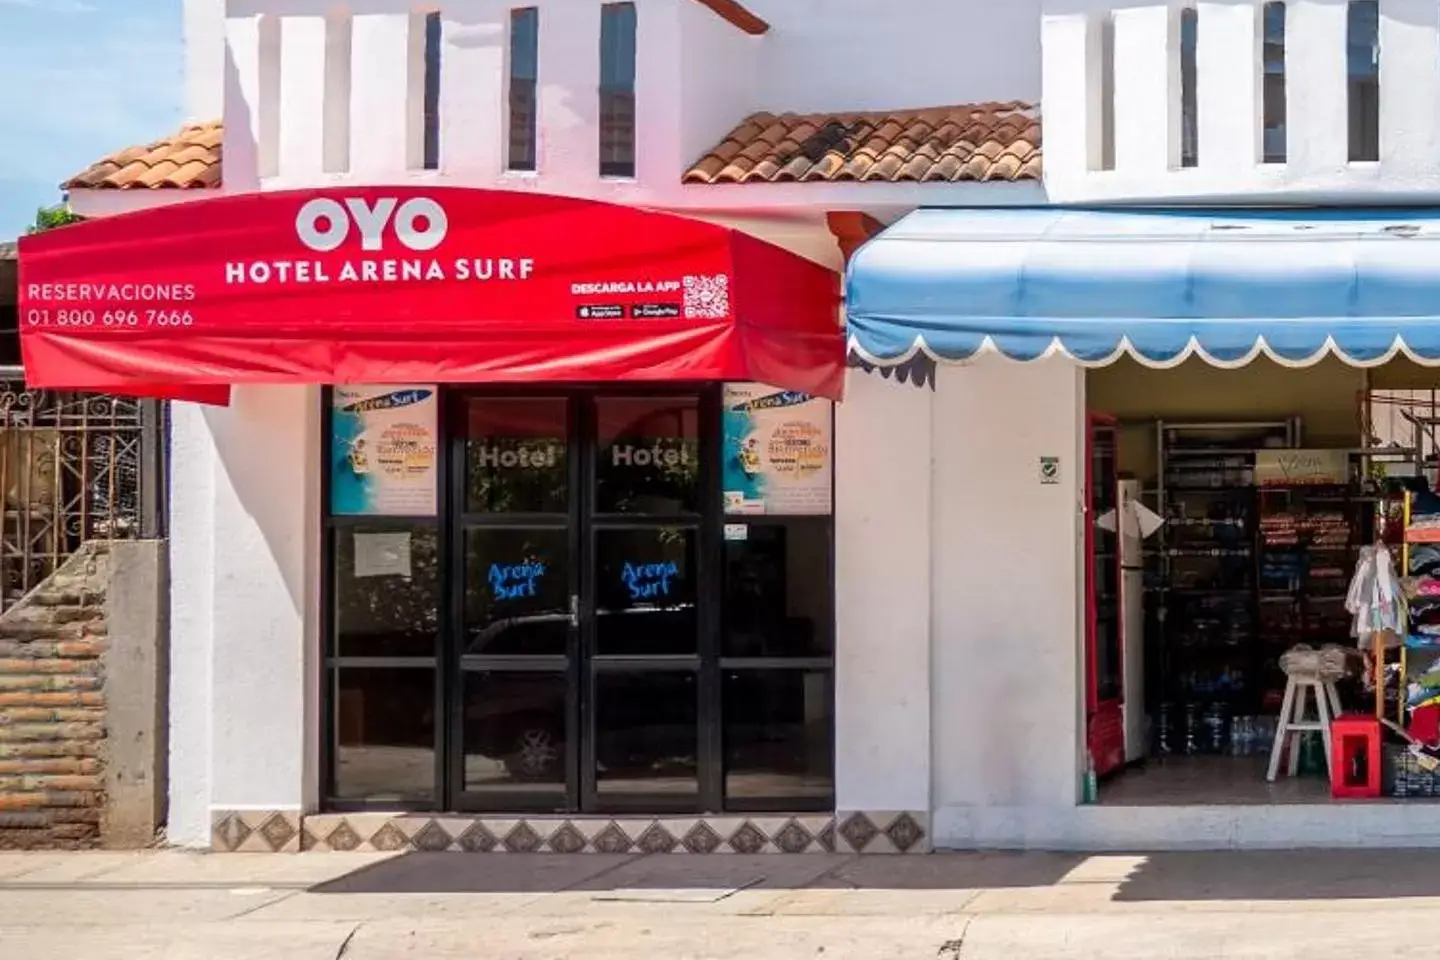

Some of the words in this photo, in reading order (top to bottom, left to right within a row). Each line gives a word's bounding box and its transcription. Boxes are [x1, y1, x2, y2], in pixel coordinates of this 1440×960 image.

[295, 197, 448, 252] OYO
[226, 261, 329, 283] HOTEL
[338, 259, 445, 281] ARENA
[455, 258, 534, 280] SURF
[27, 283, 196, 301] RESERVACIONES
[571, 283, 634, 294] DESCARGA
[637, 282, 653, 292] LA
[655, 281, 680, 291] APP
[28, 311, 50, 326] 01
[57, 310, 95, 326] 800
[102, 310, 138, 326] 696
[146, 310, 193, 326] 7666
[479, 446, 556, 468] Hotel
[612, 445, 689, 467] Hotel
[489, 563, 544, 583] Arena
[622, 562, 678, 583] Arena
[494, 579, 536, 600] Surf
[628, 579, 670, 598] Surf
